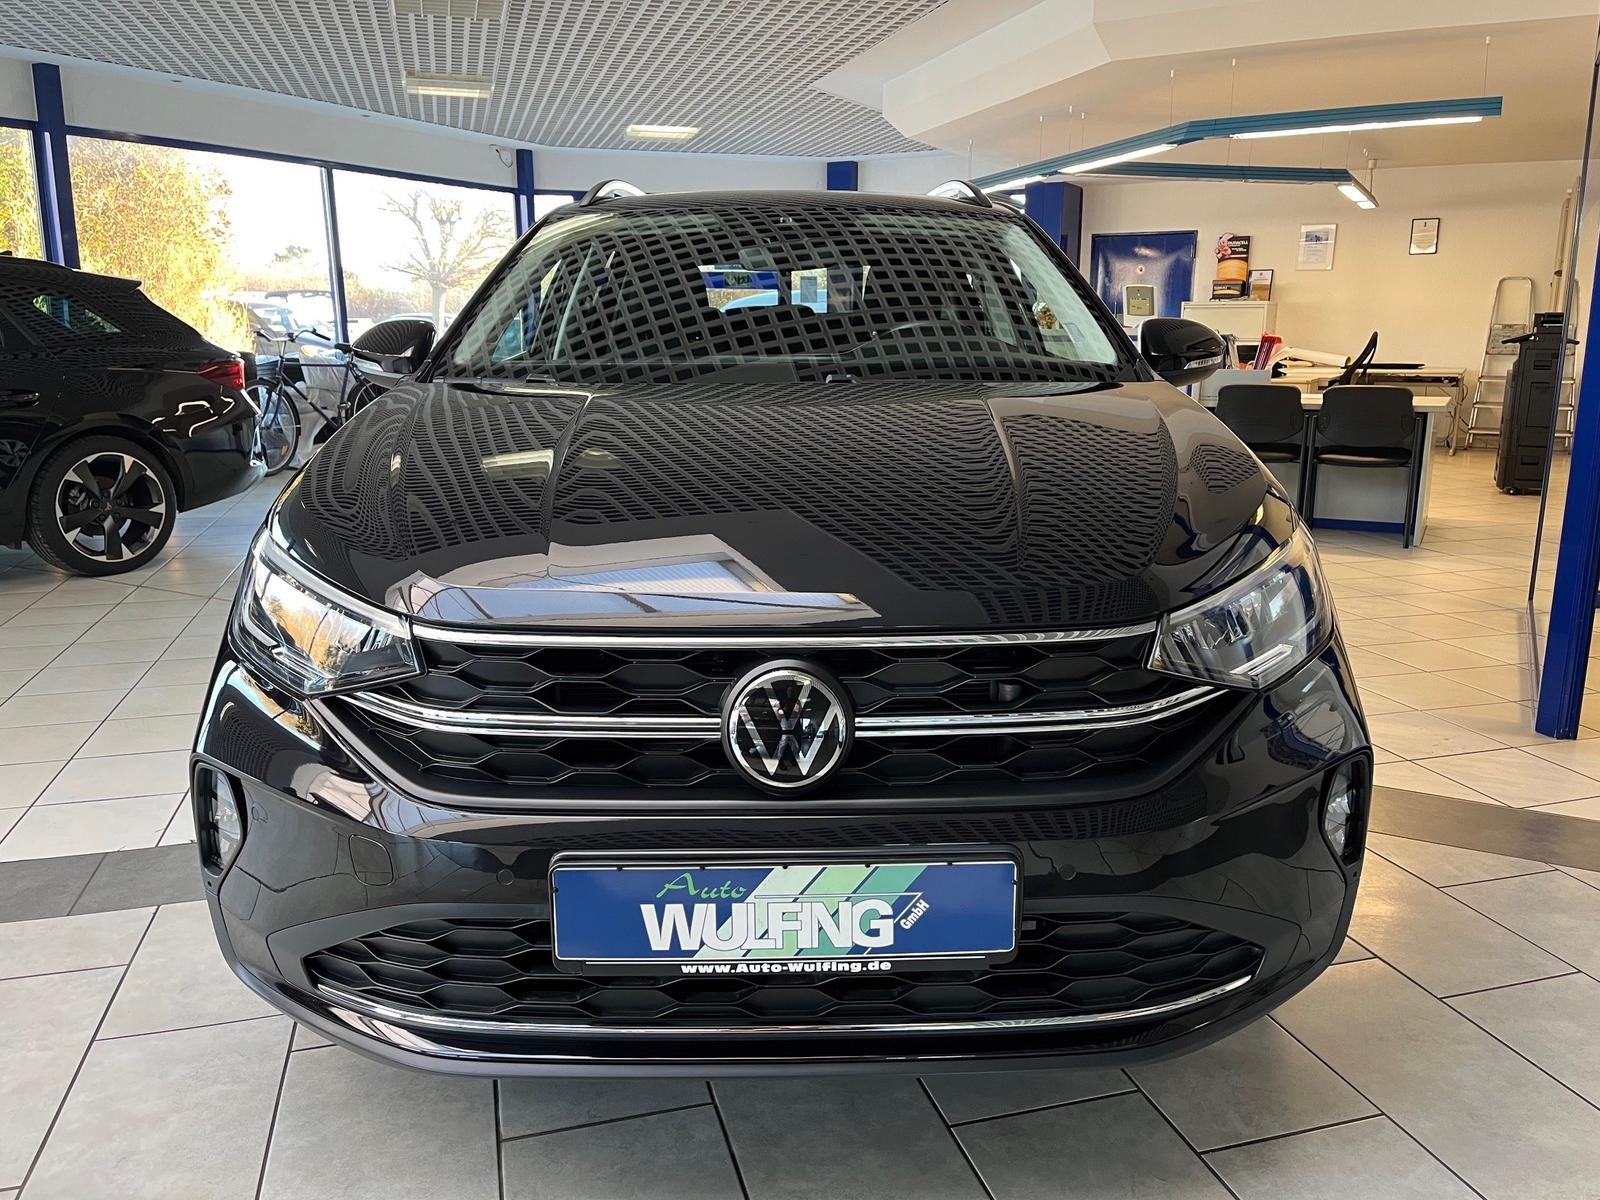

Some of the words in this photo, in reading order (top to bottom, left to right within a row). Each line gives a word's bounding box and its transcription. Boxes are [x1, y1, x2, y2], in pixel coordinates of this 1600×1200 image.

[735, 678, 838, 776] VW
[656, 872, 747, 898] Auto
[640, 899, 894, 951] WULFING
[900, 899, 930, 930] GmbH
[681, 961, 892, 974] www.Auto-Wulfing.de
